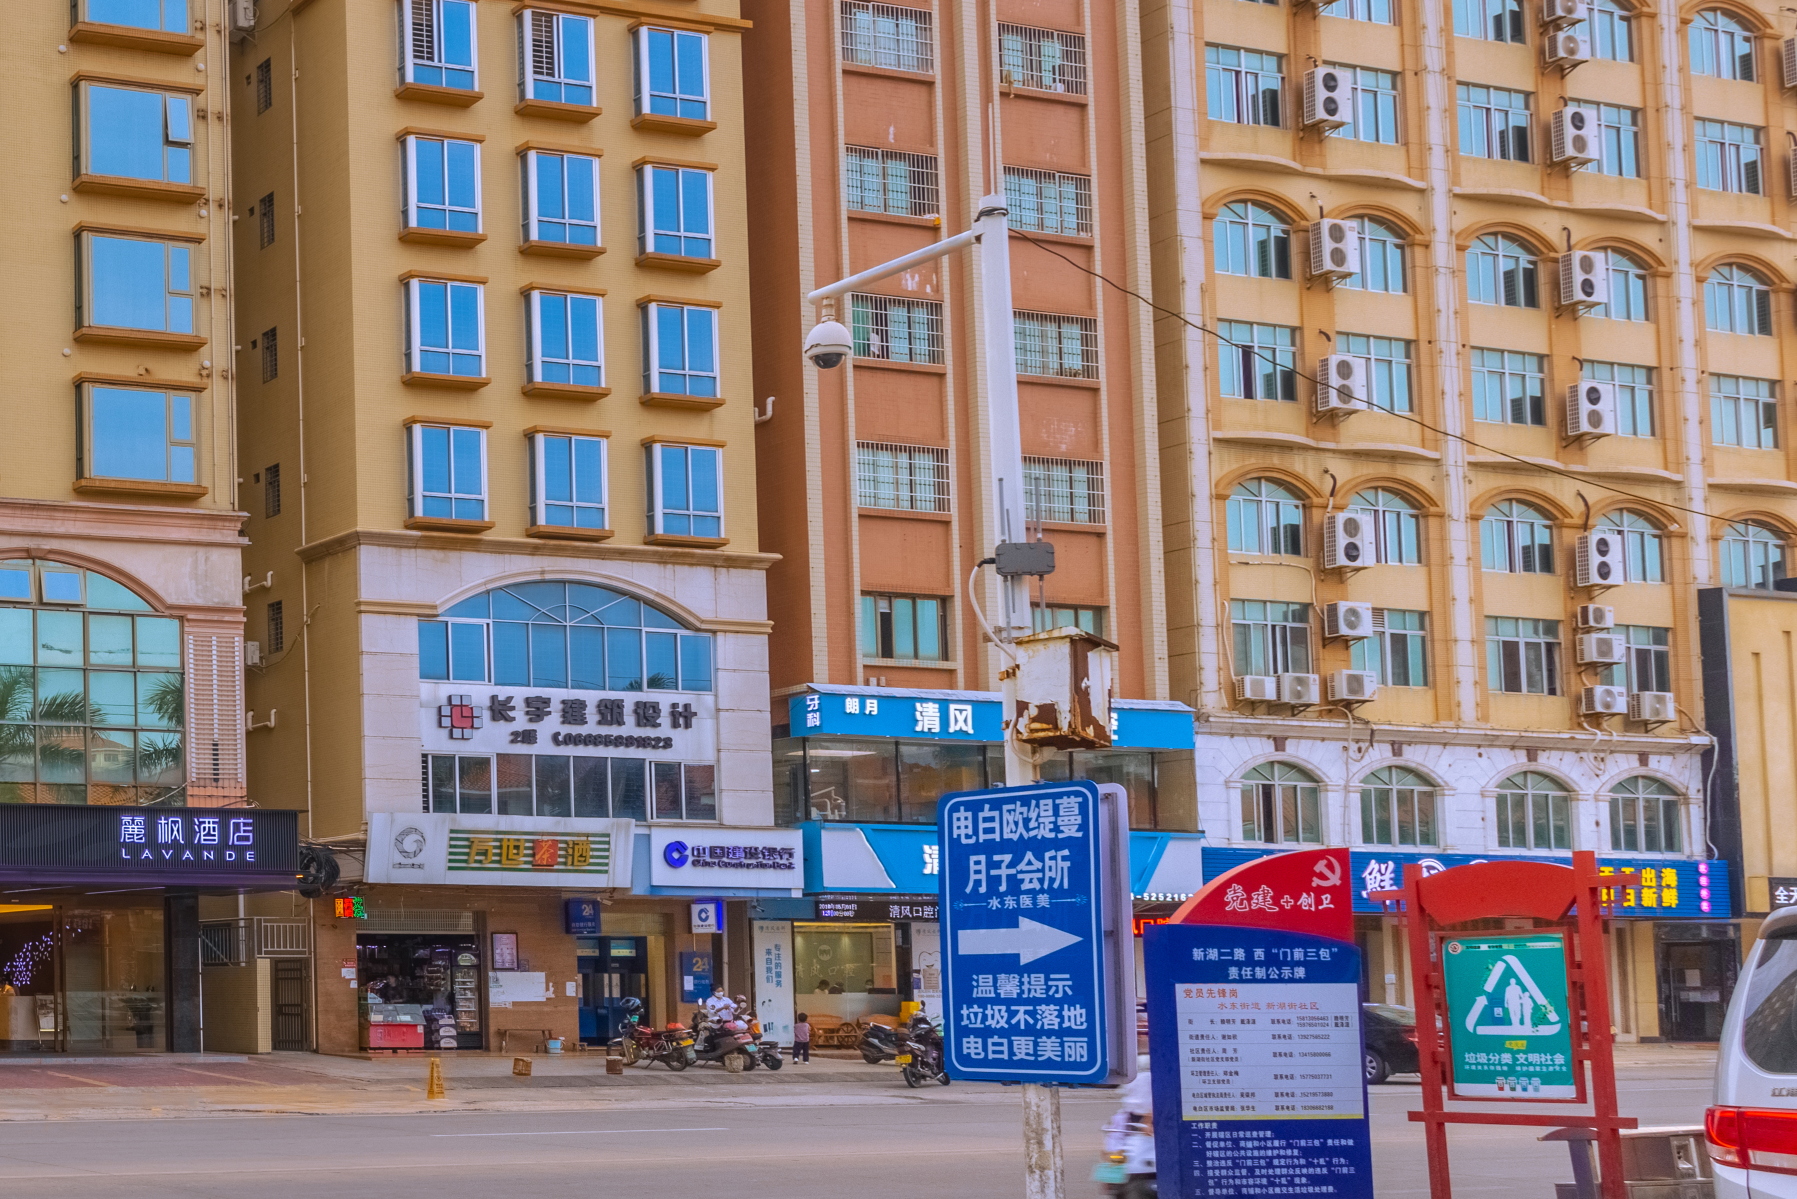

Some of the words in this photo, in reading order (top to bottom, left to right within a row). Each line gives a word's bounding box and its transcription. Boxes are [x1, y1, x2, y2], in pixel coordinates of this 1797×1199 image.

[490, 694, 697, 730] 长宇建筑设计
[806, 694, 821, 728] 牙科
[844, 696, 879, 716] 朗月
[509, 728, 538, 744] 2楼
[952, 795, 1084, 845] 电白欧缇蔓
[119, 815, 255, 847] 麗枫酒店
[121, 847, 256, 862] LAVANDE
[468, 835, 592, 868] 万世茶酒
[691, 845, 796, 861] 中国建设银行
[964, 848, 1071, 896] 月子会所
[987, 893, 1052, 911] 水东医美
[1224, 883, 1335, 913] 党建+创卫
[582, 904, 595, 916] 24
[1192, 947, 1246, 961] 新湖二路
[1252, 948, 1265, 961] 西
[693, 957, 709, 972] 24
[765, 948, 774, 984] 来自我们
[774, 943, 782, 988] 专注的服务
[1227, 966, 1306, 980] 责任制公示牌
[971, 973, 1073, 999] 温馨提示
[1183, 987, 1239, 999] 党员先锋岗
[1217, 1002, 1262, 1011] 水东街道
[1265, 1001, 1320, 1011] 新湖街社区
[960, 1004, 1088, 1031] 垃圾不落地
[961, 1035, 1089, 1063] 电白更美丽
[1464, 1052, 1513, 1065] 垃圾分类
[1515, 1052, 1566, 1065] 文明社会
[1191, 1122, 1218, 1130] 工作职责
